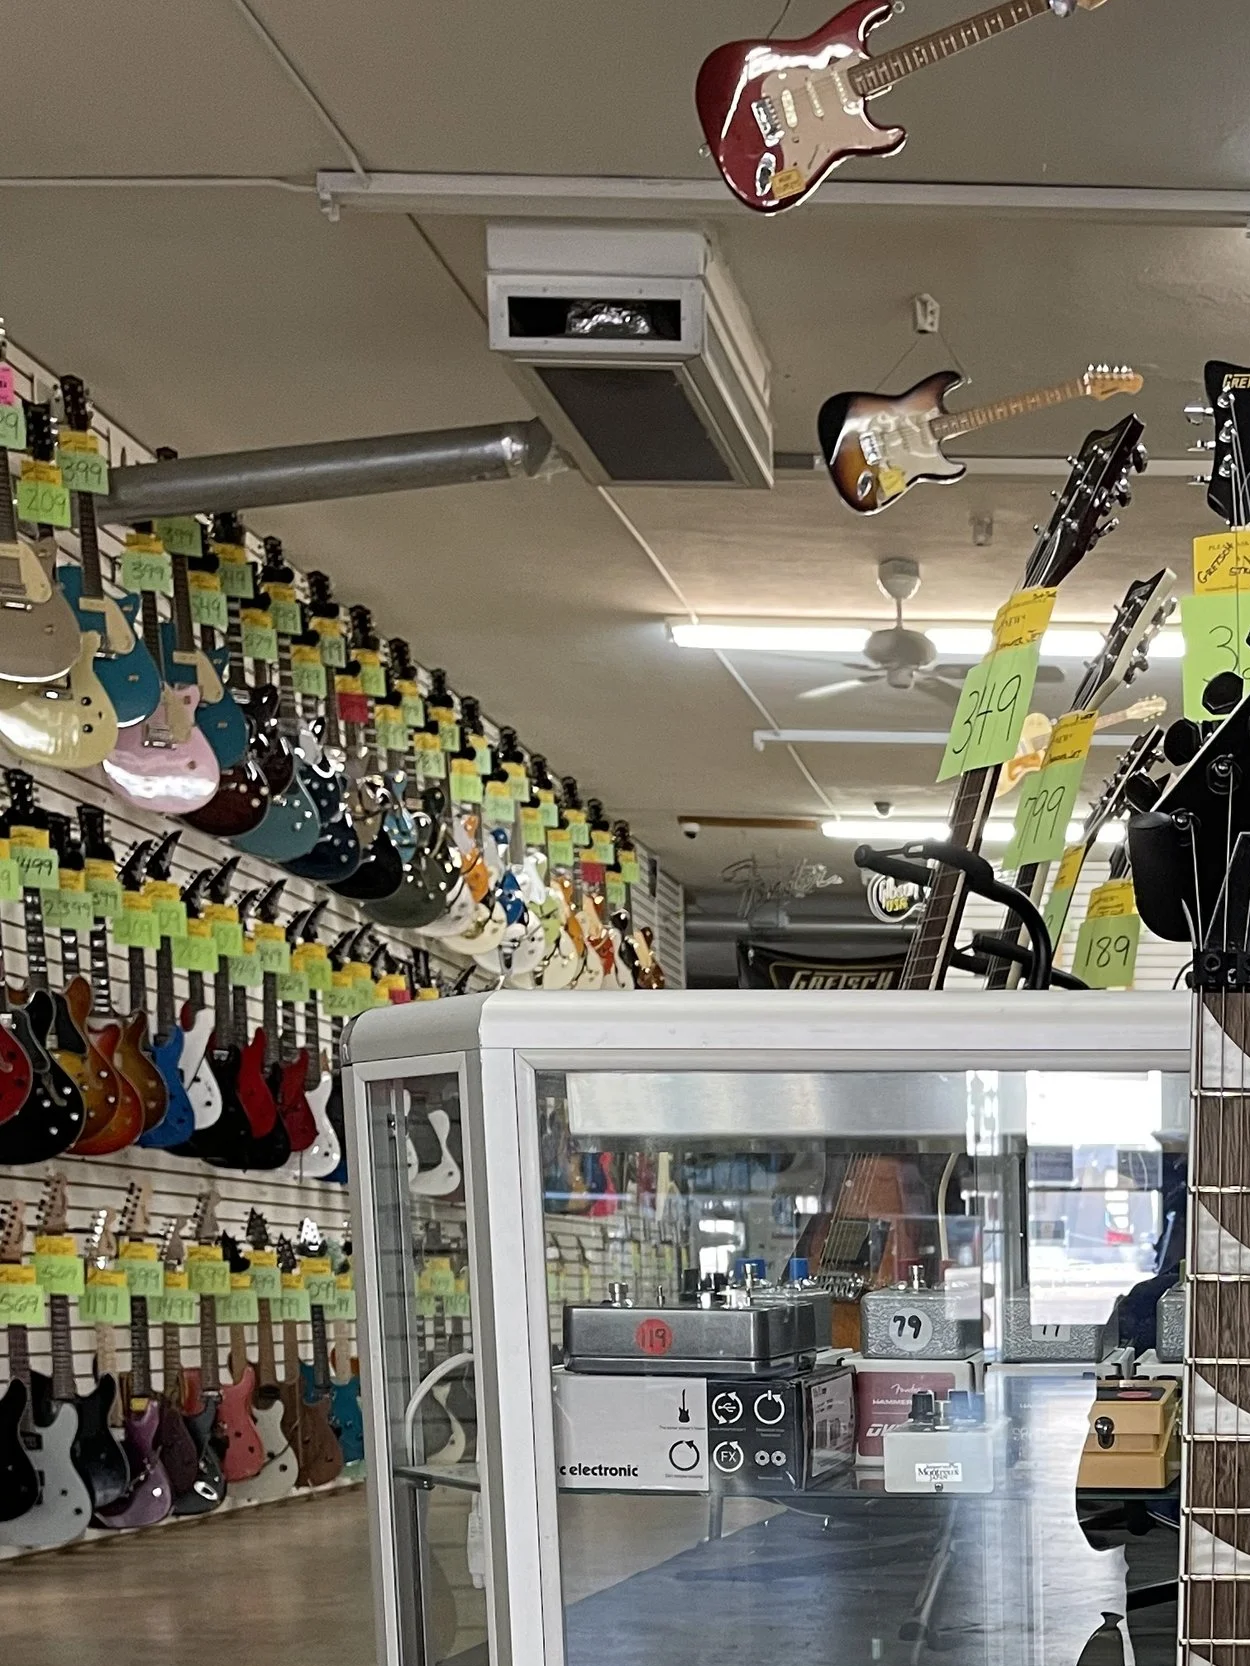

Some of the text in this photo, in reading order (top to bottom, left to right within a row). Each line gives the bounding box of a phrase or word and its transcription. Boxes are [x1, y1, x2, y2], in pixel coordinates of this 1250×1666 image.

[952, 674, 1022, 755] 349
[1017, 785, 1066, 850] 799
[1085, 935, 1131, 968] 189
[641, 1328, 666, 1349] 119
[893, 1314, 922, 1339] 79
[721, 1451, 737, 1463] FX
[558, 1463, 639, 1477] c electronic
